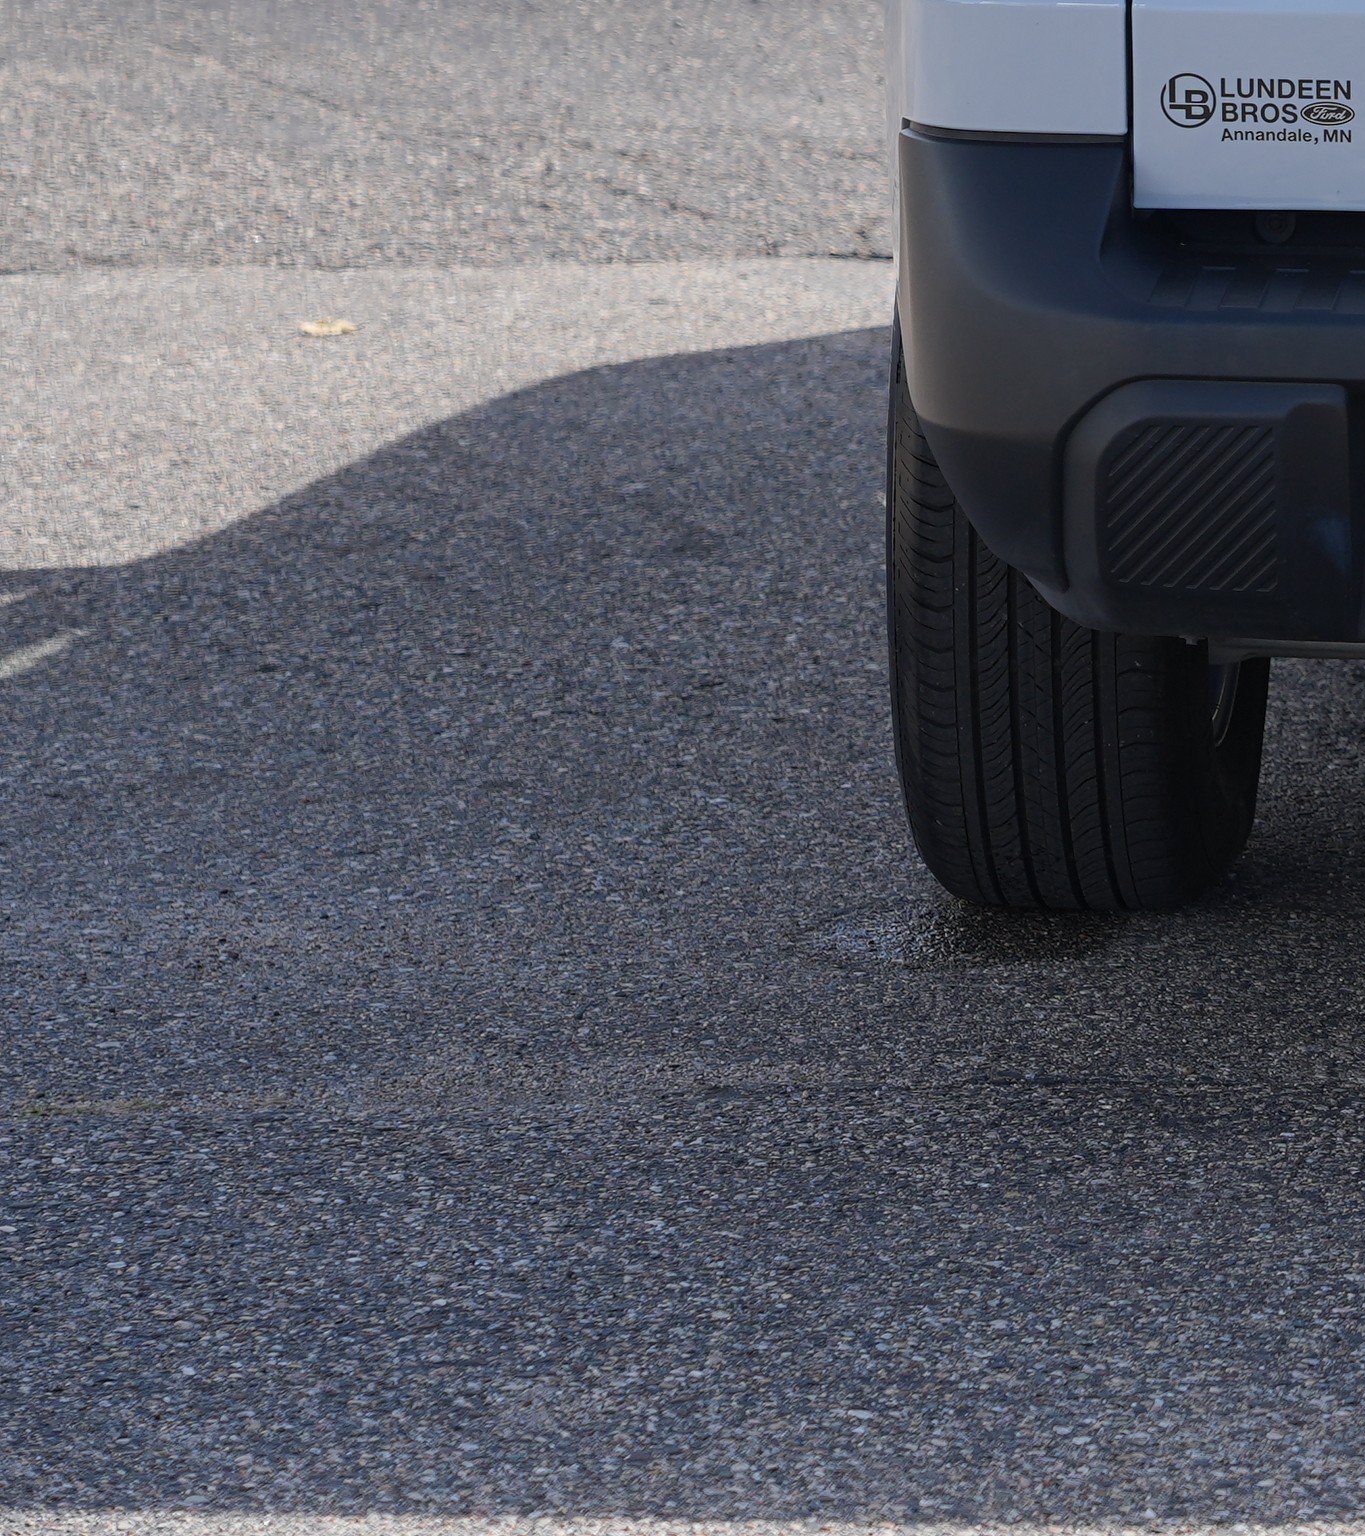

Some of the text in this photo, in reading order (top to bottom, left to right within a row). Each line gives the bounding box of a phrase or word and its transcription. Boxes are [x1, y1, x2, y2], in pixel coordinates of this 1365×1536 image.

[1220, 77, 1352, 100] LUNDEEN
[1221, 102, 1299, 124] BROS
[1221, 128, 1352, 145] Annandale, MN
